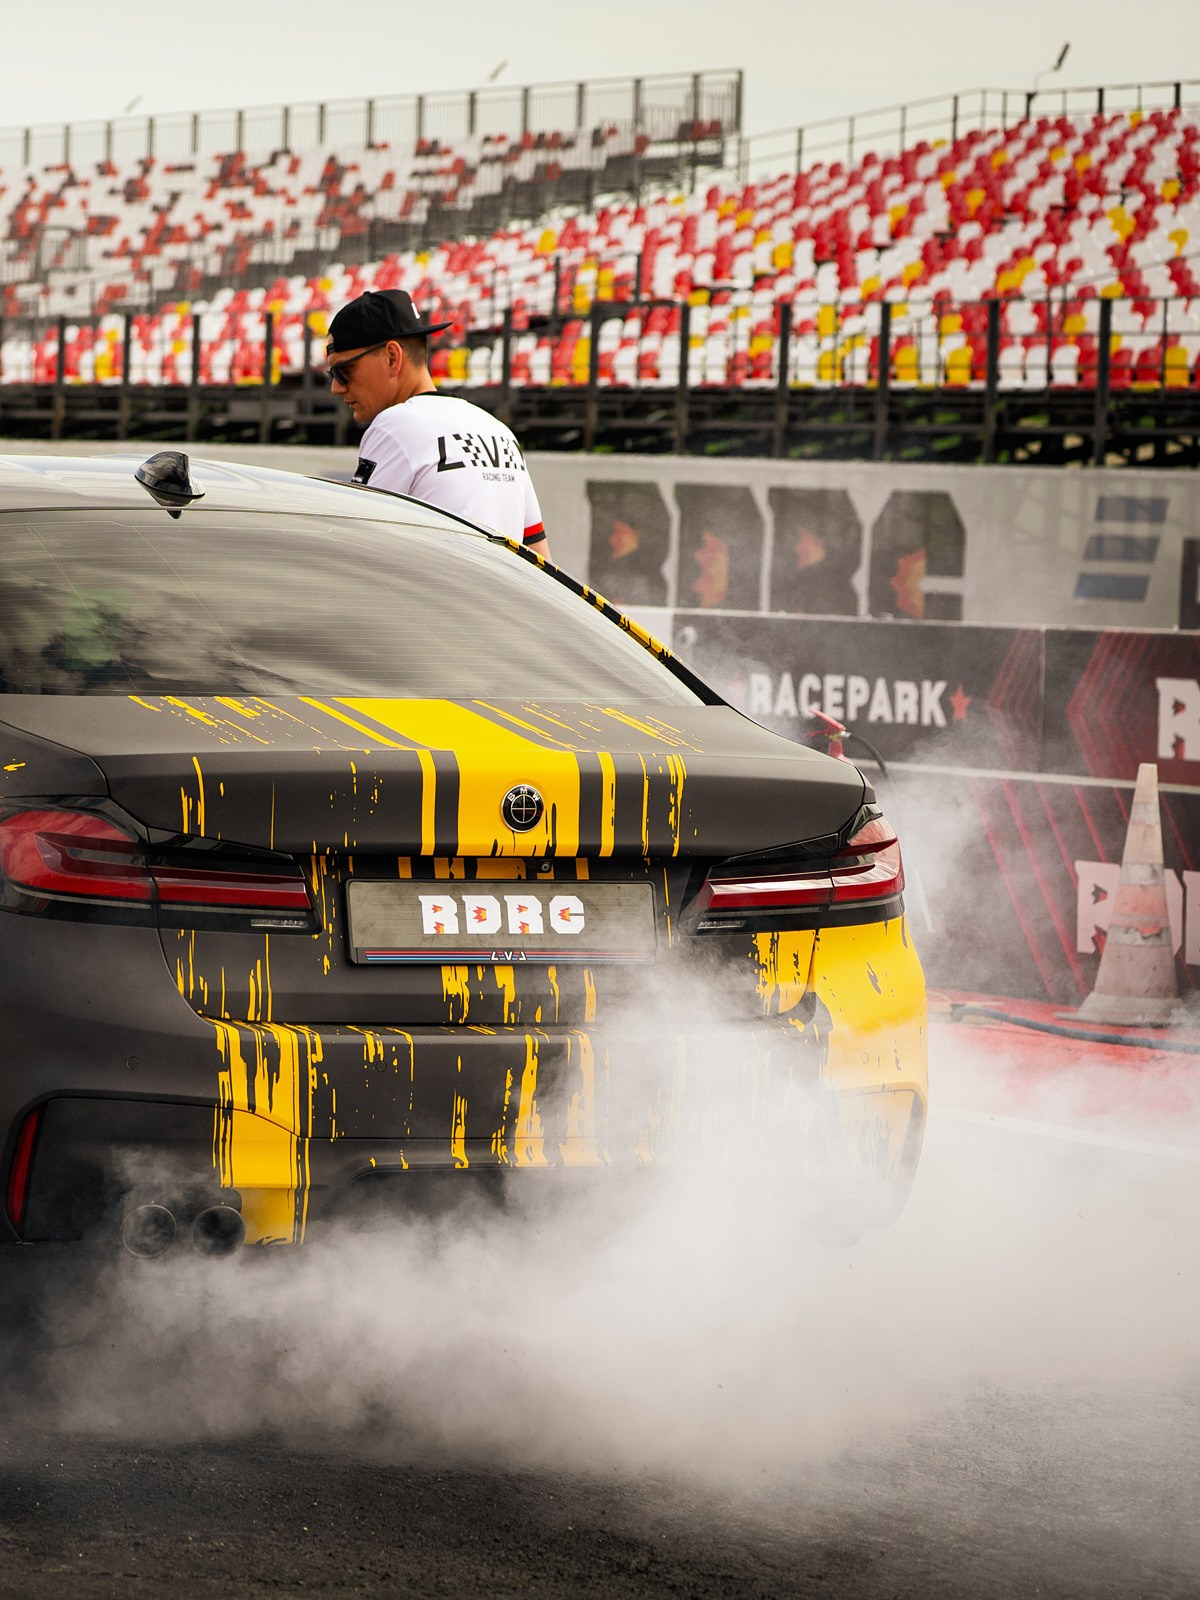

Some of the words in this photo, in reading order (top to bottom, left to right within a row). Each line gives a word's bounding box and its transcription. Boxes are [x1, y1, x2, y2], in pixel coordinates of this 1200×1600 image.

[482, 472, 502, 482] RACING
[503, 473, 515, 482] TEAM
[751, 672, 948, 728] RACEPARK
[507, 787, 541, 801] BMW
[418, 895, 585, 934] RDRC
